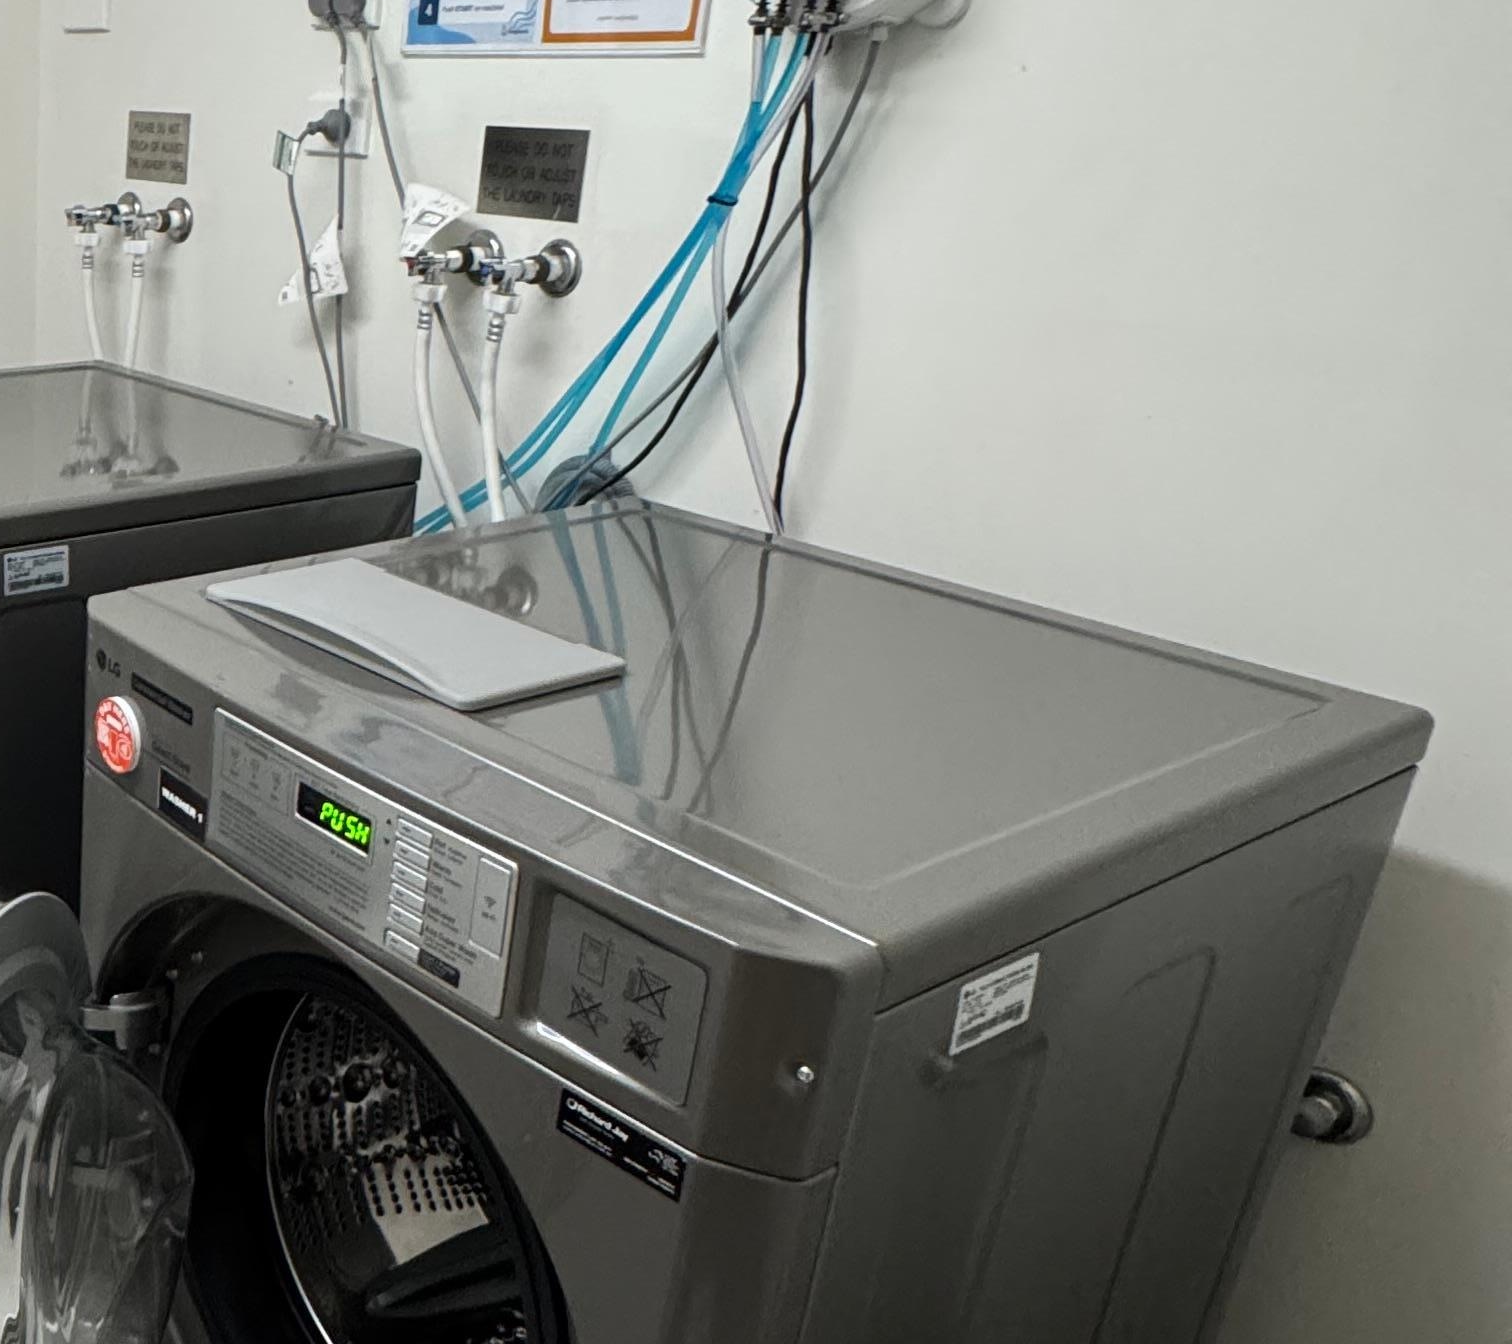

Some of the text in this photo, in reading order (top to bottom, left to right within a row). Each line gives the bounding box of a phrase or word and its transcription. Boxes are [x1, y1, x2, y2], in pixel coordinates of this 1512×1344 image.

[424, 3, 433, 16] 4
[161, 786, 204, 824] WASHER 1
[319, 802, 370, 844] PUSH
